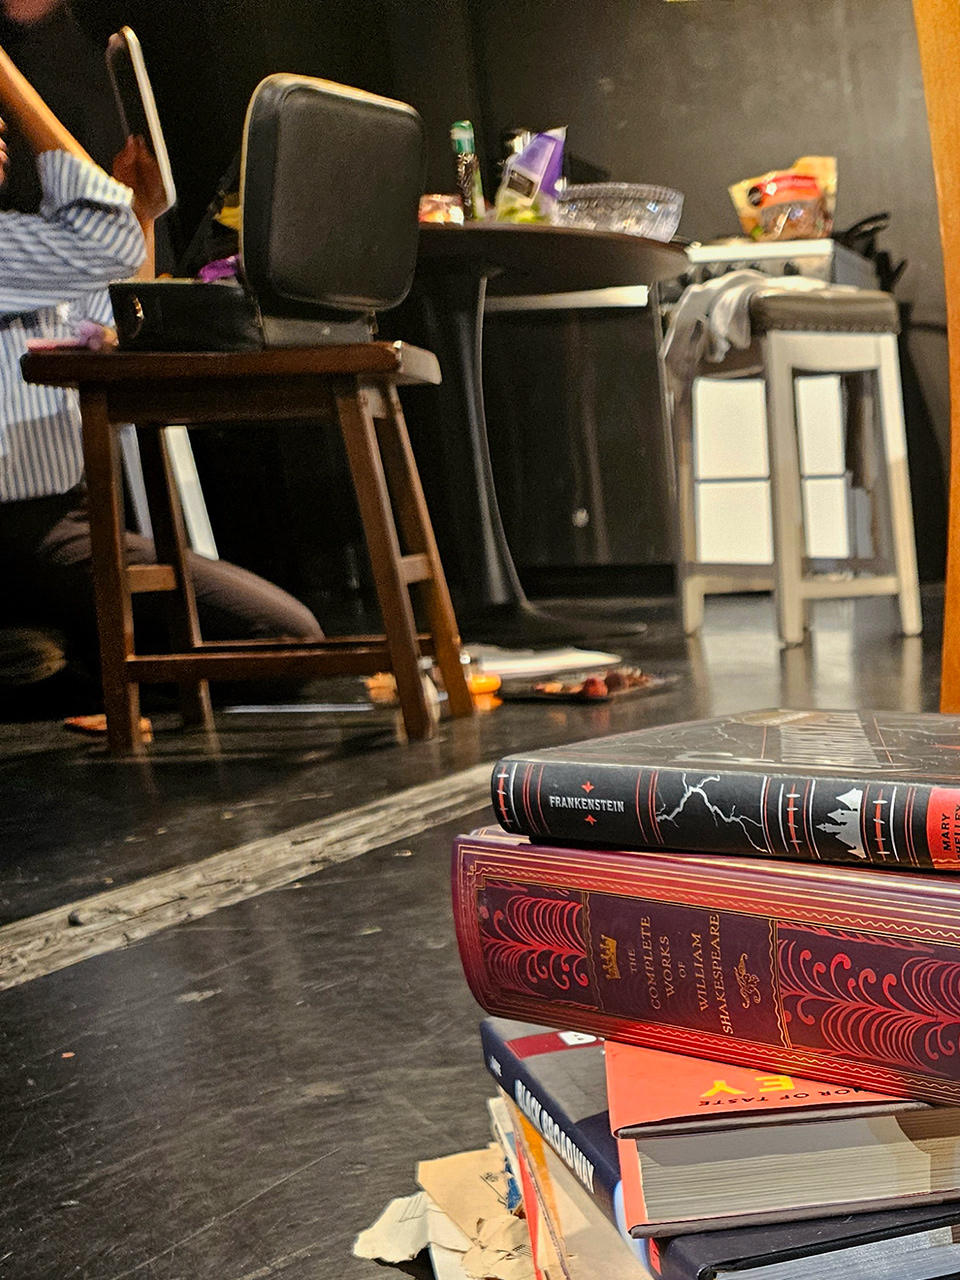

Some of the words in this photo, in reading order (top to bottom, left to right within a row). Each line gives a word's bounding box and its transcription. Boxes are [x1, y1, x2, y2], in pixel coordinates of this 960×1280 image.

[549, 795, 625, 812] FRANKENSTEIN
[941, 813, 952, 851] MARY
[628, 949, 638, 975] THE
[640, 916, 661, 1010] COMPLETE
[660, 935, 675, 998] WORKS
[677, 961, 687, 979] OF
[691, 932, 709, 1012] WILLIAM
[709, 914, 734, 1035] SHAKESPEARE
[699, 1096, 769, 1107] TASTE
[779, 1092, 809, 1100] OF
[514, 1079, 545, 1134] BLACK
[540, 1109, 596, 1195] BROADWAY
